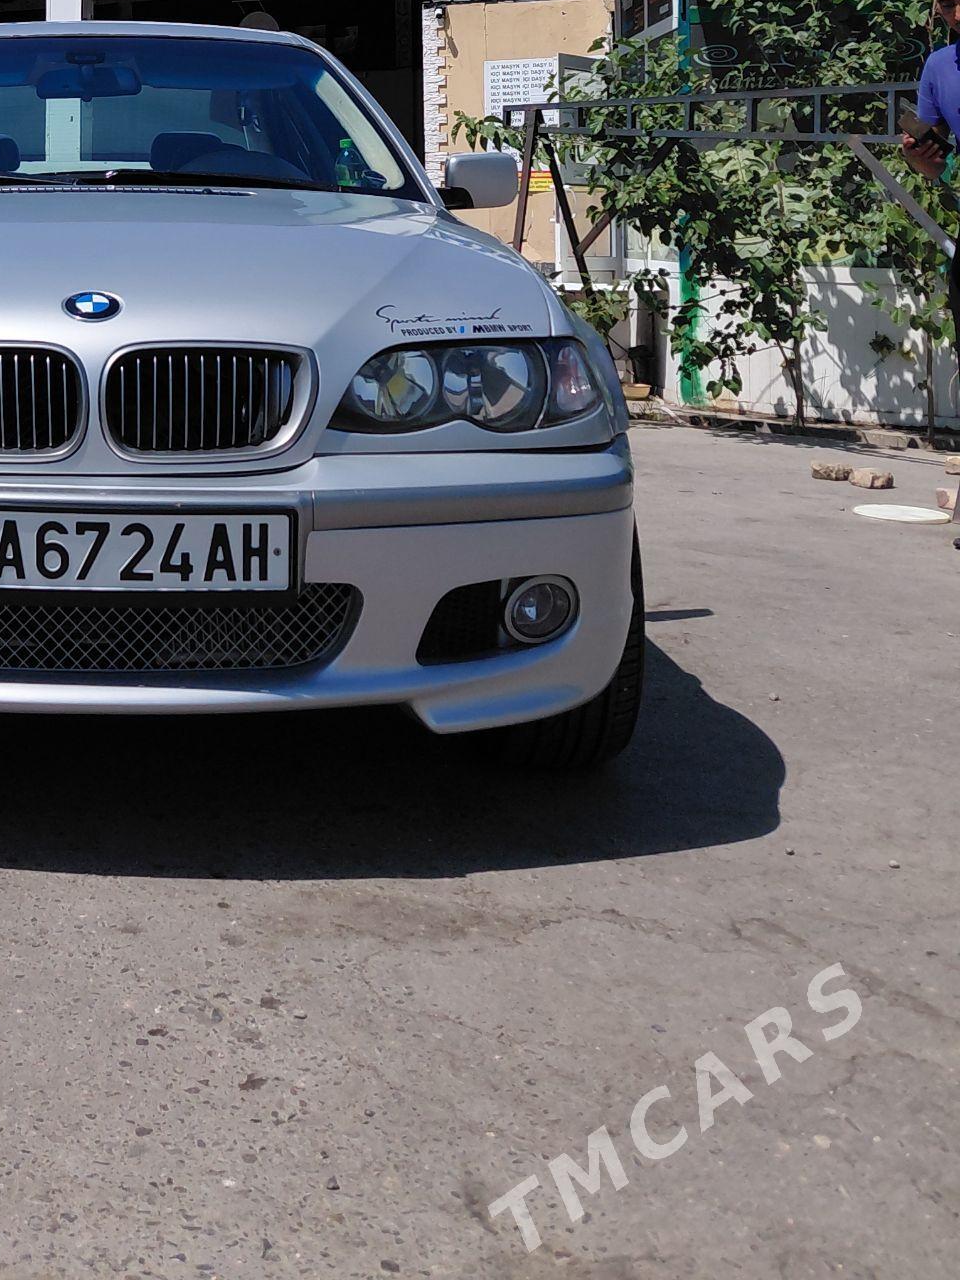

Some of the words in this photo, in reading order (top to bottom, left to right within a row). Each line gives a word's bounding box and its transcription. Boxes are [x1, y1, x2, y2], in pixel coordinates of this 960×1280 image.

[401, 327, 446, 337] PRODUCED
[447, 326, 458, 334] BY
[507, 324, 534, 332] SPORT
